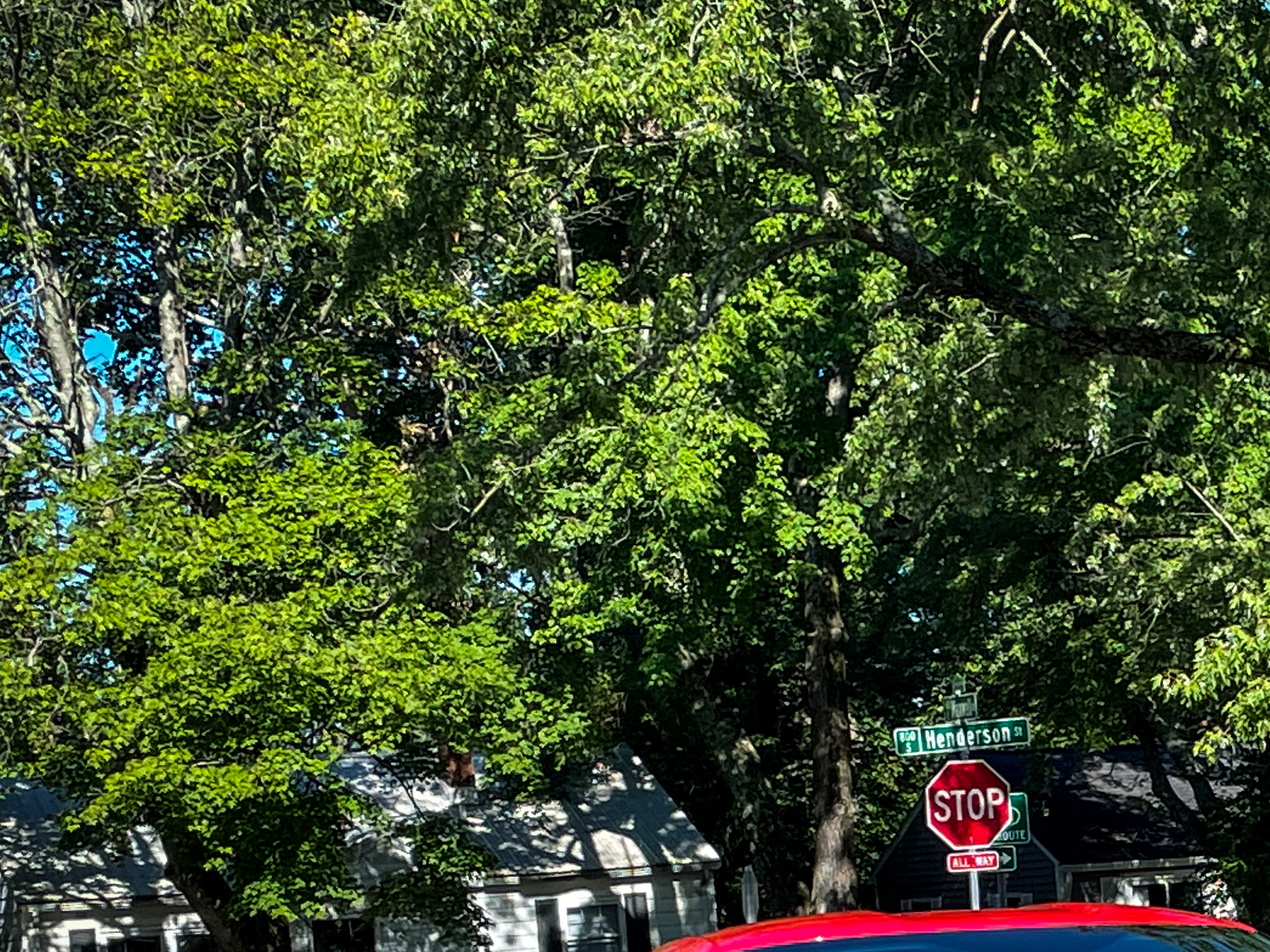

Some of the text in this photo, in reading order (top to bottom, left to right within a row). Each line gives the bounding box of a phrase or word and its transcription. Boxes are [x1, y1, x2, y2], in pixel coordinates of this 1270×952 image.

[925, 726, 1011, 749] Henderson
[934, 788, 1005, 822] STOP
[952, 855, 995, 868] ALL WAY
